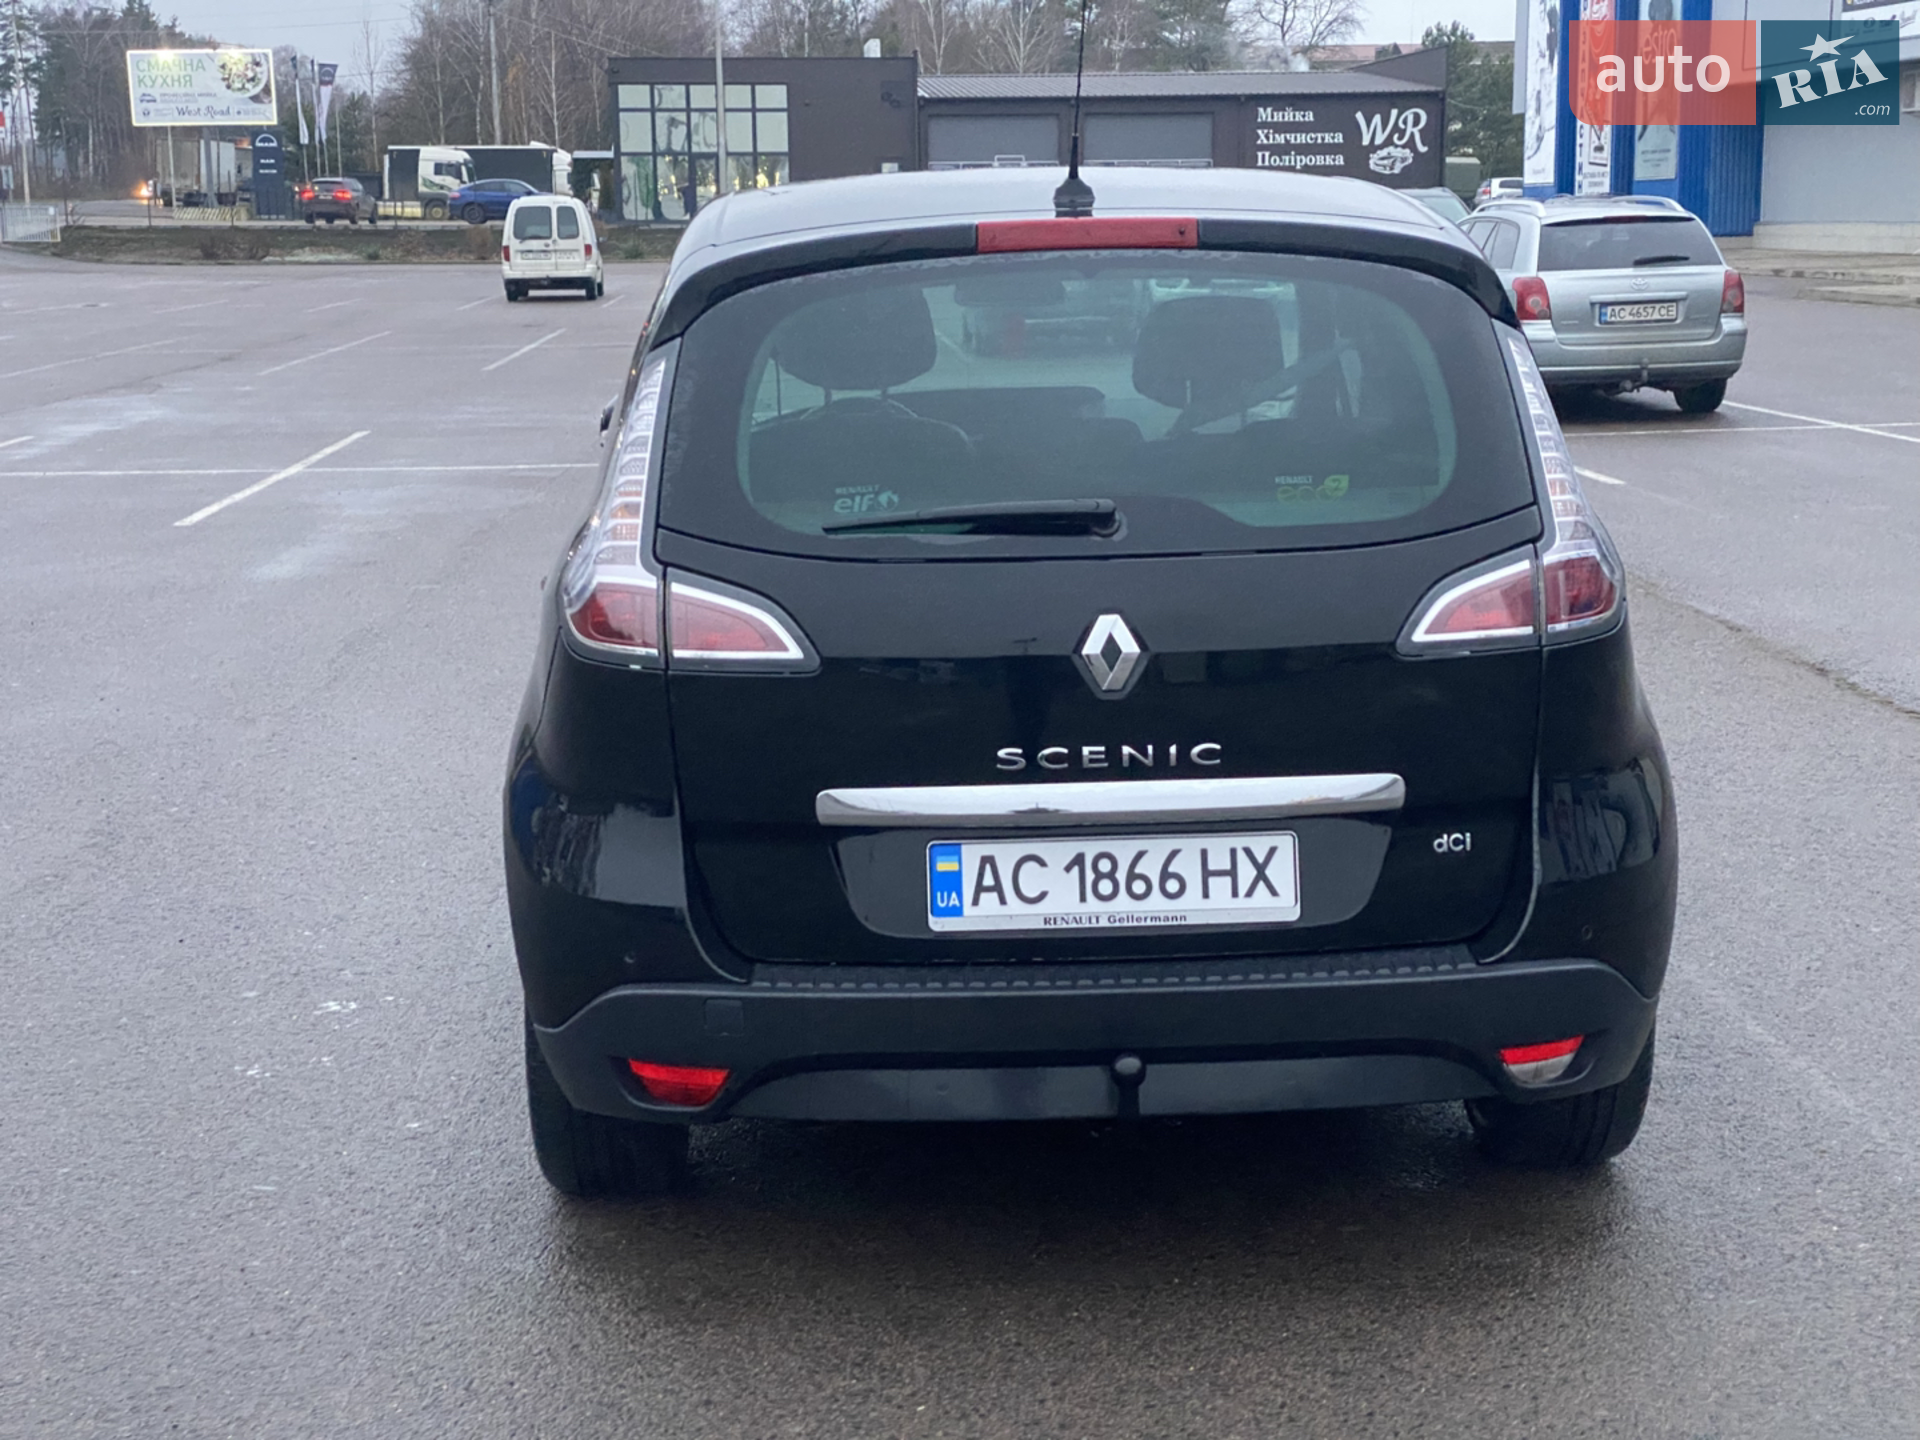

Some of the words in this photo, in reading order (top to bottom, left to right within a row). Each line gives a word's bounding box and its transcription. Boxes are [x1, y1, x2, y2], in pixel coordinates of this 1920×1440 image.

[135, 59, 206, 73] СМАЧНА
[137, 75, 193, 88] КУХНЯ
[175, 105, 201, 117] West
[203, 105, 231, 119] Road
[1257, 106, 1314, 122] Мийка
[1256, 129, 1344, 144] Хімчистка
[1355, 108, 1428, 153] WR
[1256, 151, 1345, 169] Поліровка
[1608, 308, 1627, 320] AC
[1628, 306, 1656, 319] 4657
[1658, 304, 1675, 317] CE
[1274, 475, 1313, 484] RENAULT
[835, 485, 879, 494] RENAULT
[833, 494, 875, 513] elf
[996, 743, 1222, 770] SCENIC
[971, 854, 1049, 907] AC
[1063, 849, 1187, 903] 1866
[1200, 846, 1280, 900] HX
[936, 890, 960, 907] UA
[1043, 915, 1100, 926] RENAULT
[1107, 913, 1187, 925] Gellermann
